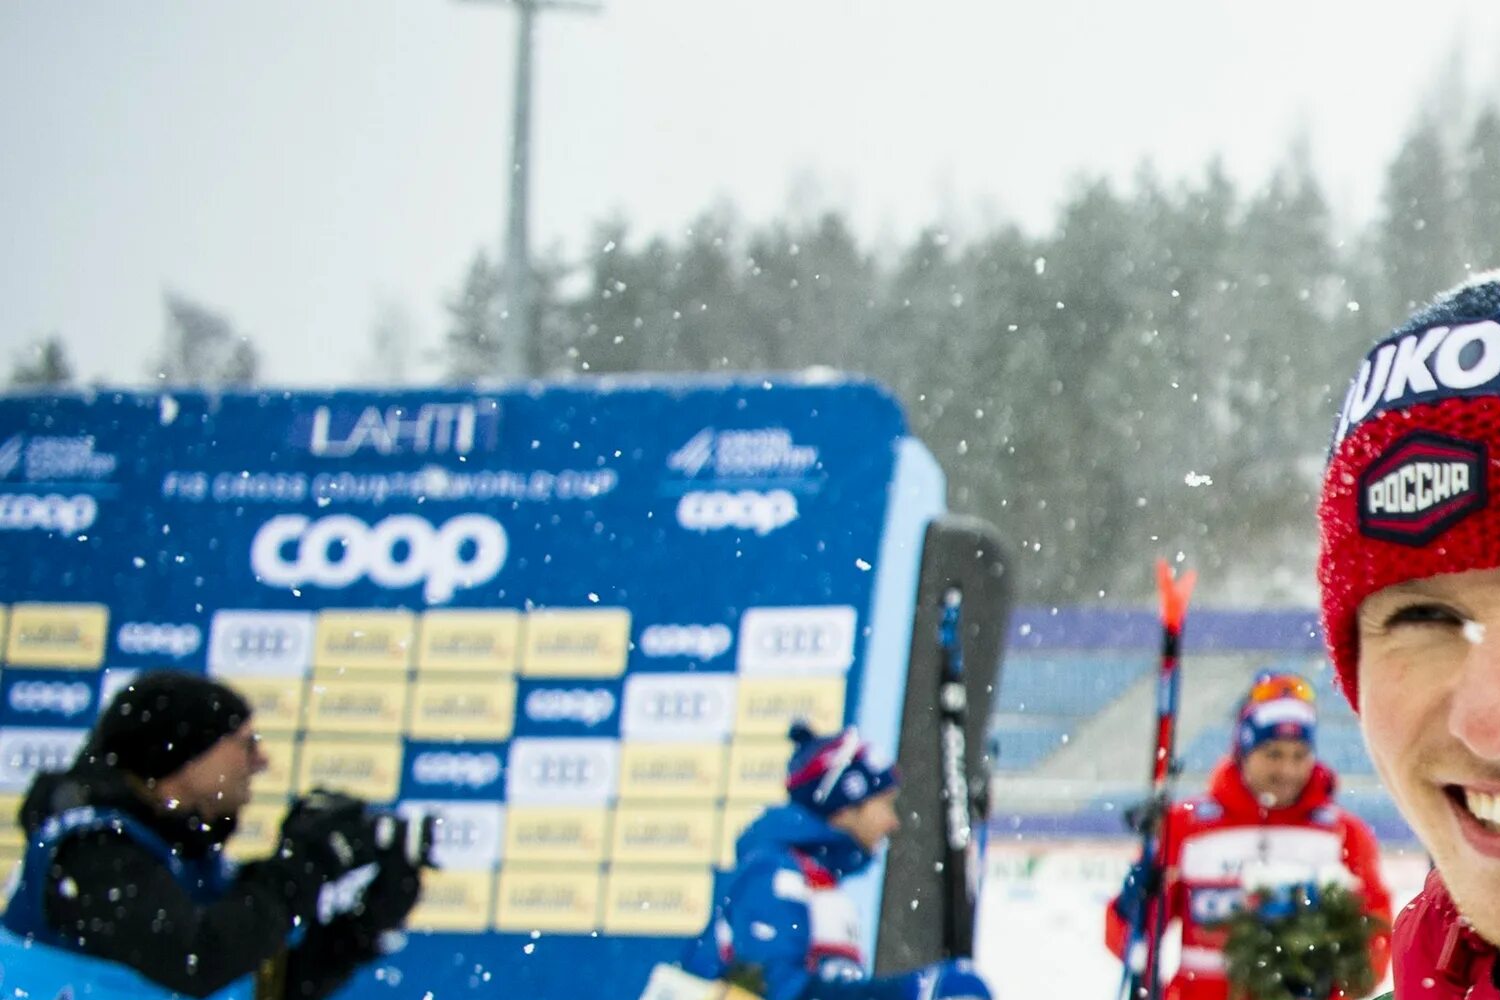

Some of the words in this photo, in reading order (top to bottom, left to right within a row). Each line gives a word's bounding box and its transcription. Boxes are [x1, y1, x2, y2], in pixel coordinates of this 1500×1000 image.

[311, 403, 477, 458] LAHTI
[676, 490, 798, 535] coop
[251, 514, 508, 603] coop
[117, 622, 201, 658] coop
[640, 624, 733, 661] coop
[10, 681, 92, 716] coop
[524, 688, 616, 726] coop
[412, 751, 500, 788] coop
